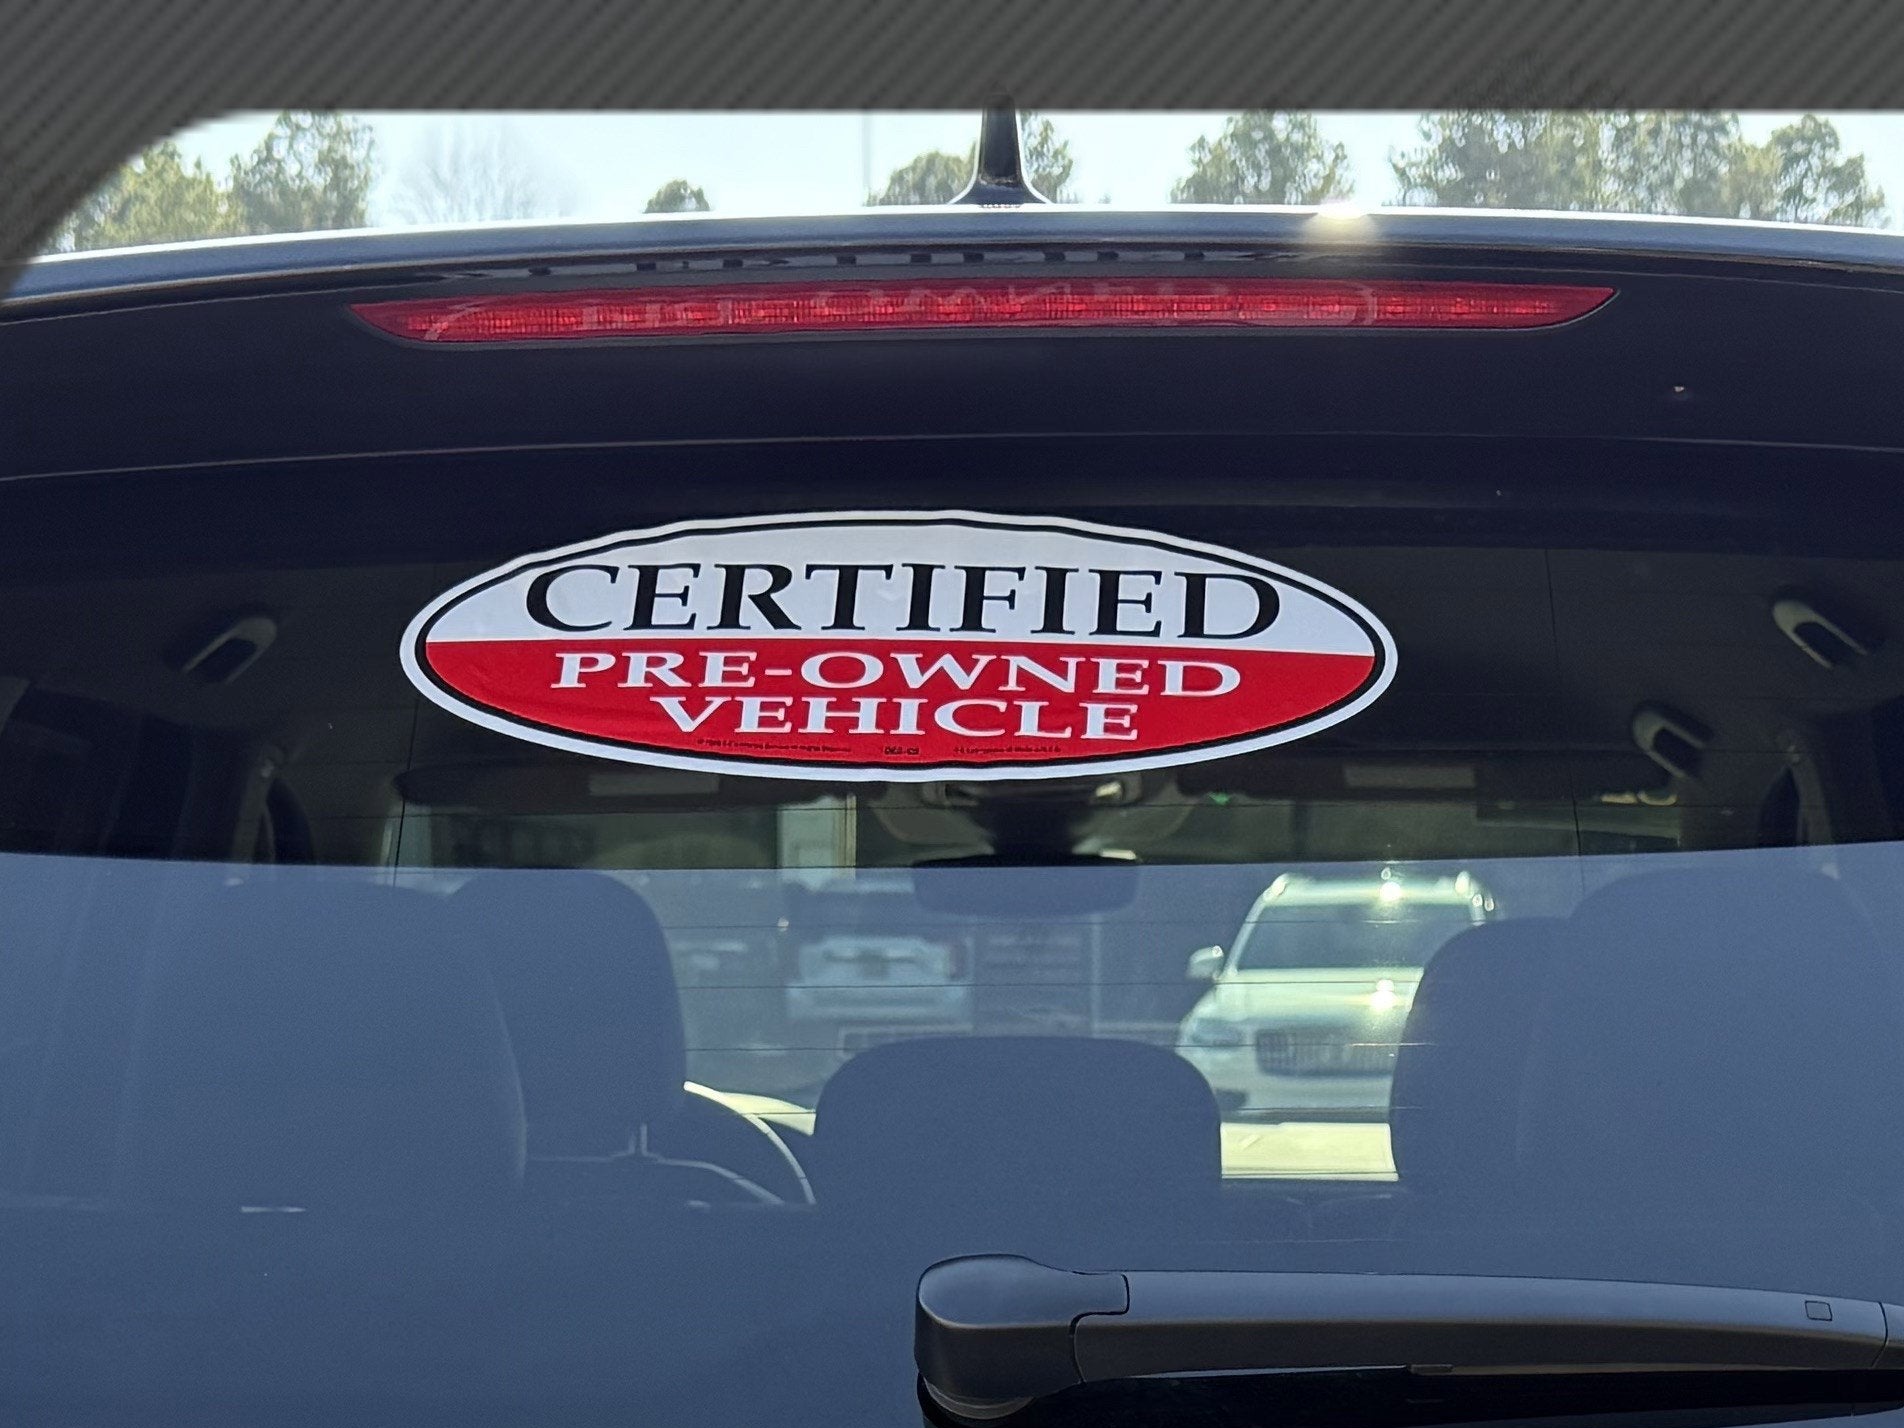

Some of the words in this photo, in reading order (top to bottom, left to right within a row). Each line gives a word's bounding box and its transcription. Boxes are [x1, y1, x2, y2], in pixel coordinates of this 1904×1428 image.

[525, 562, 1281, 640] CERTIFIED
[550, 651, 1242, 698] PRE-OWNED
[649, 695, 1140, 741] VEHICLE
